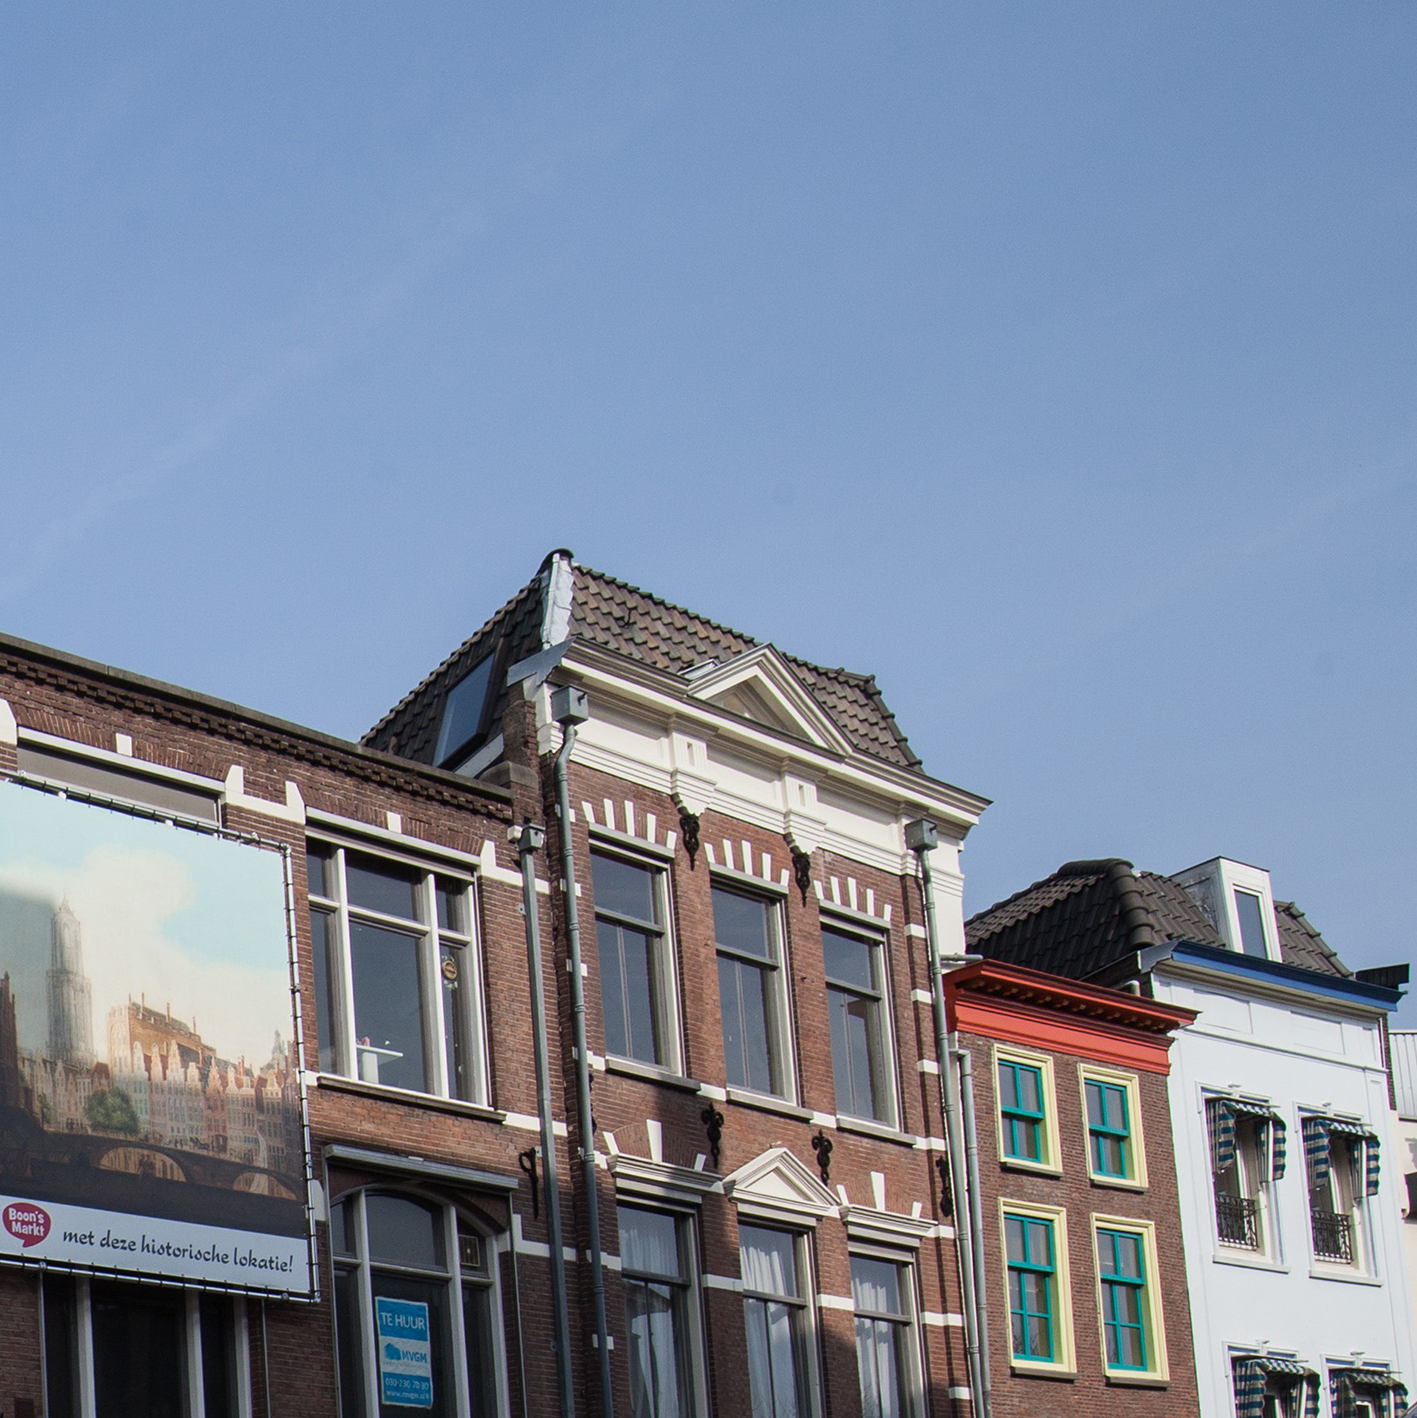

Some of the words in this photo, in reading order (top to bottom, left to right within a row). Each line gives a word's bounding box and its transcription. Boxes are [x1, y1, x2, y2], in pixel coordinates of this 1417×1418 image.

[8, 1207, 45, 1224] Boon's
[11, 1221, 45, 1237] Markt
[63, 1230, 95, 1246] met
[99, 1229, 137, 1252] deze
[141, 1234, 229, 1265] historische
[233, 1247, 293, 1273] lokatie!
[380, 1312, 394, 1326] TE
[395, 1313, 426, 1330] HUUR
[402, 1350, 427, 1364] MVGM
